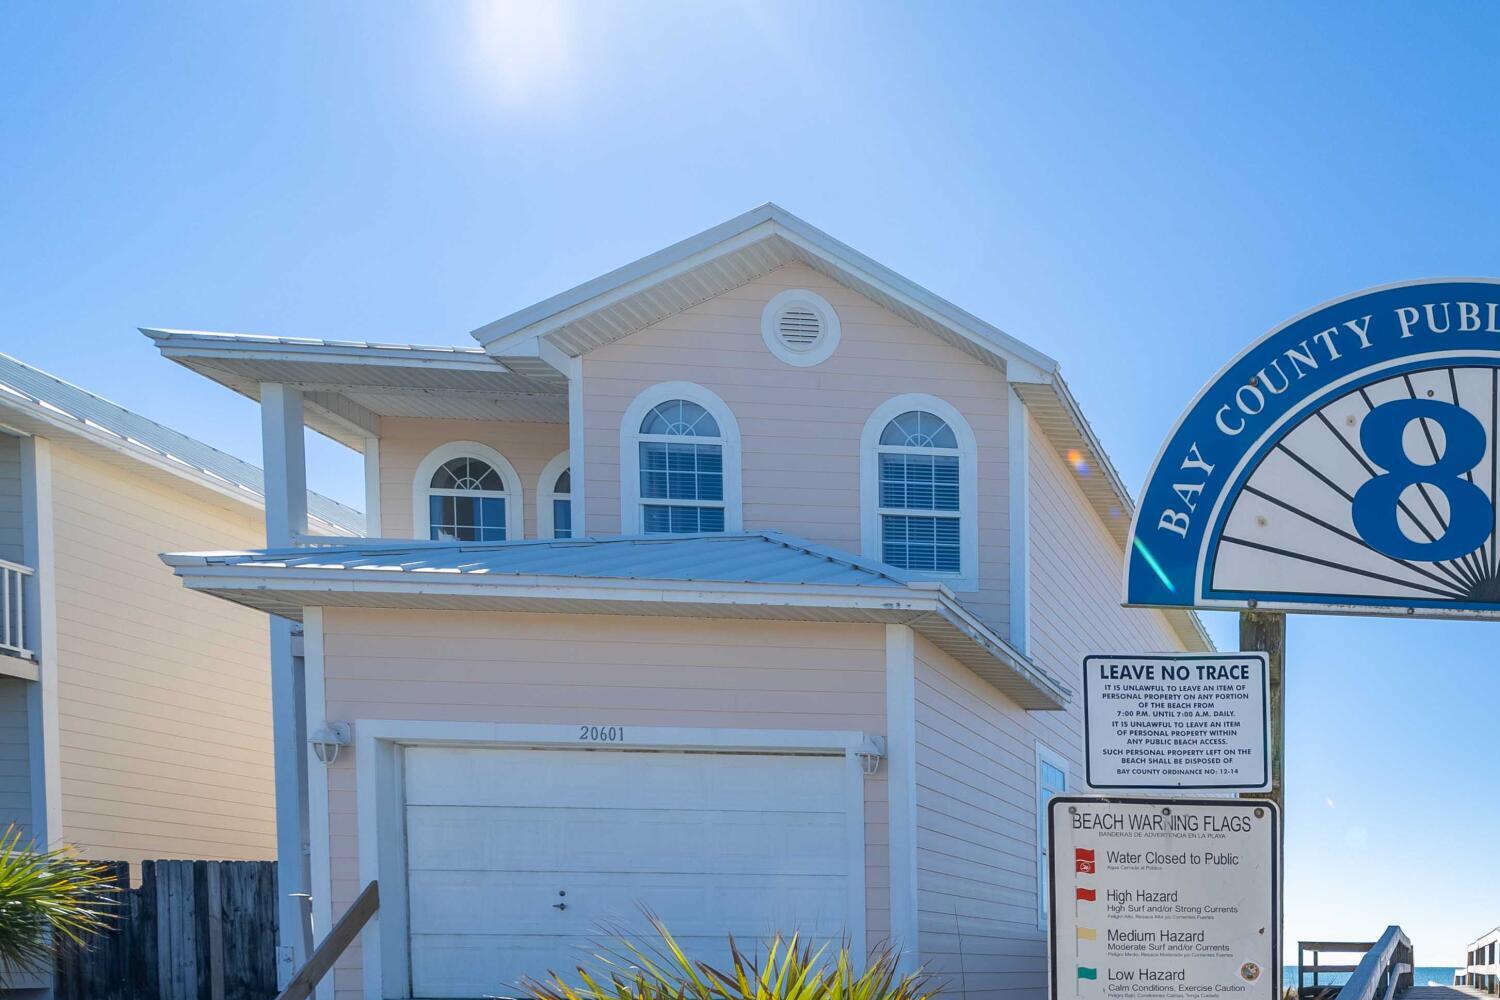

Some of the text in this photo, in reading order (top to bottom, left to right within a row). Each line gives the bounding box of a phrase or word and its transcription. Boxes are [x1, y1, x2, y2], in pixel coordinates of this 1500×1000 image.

[1157, 442, 1217, 540] BAY
[1215, 315, 1375, 437] COUNTY
[1101, 665, 1249, 680] LEAVE NO TRACE
[580, 726, 623, 741] 20601
[1072, 813, 1251, 832] BEACH WARNING FLAGS
[1107, 851, 1239, 865] Water Closed to Public
[1107, 890, 1178, 904] High Hazard
[1108, 905, 1238, 913] High Surf and/or Strong Currents
[1108, 929, 1204, 942] Medium Hazard
[1109, 968, 1185, 980] Low Hazard
[1109, 984, 1129, 992] Calm
[1179, 984, 1212, 992] Exercise
[1215, 984, 1245, 992] Caution
